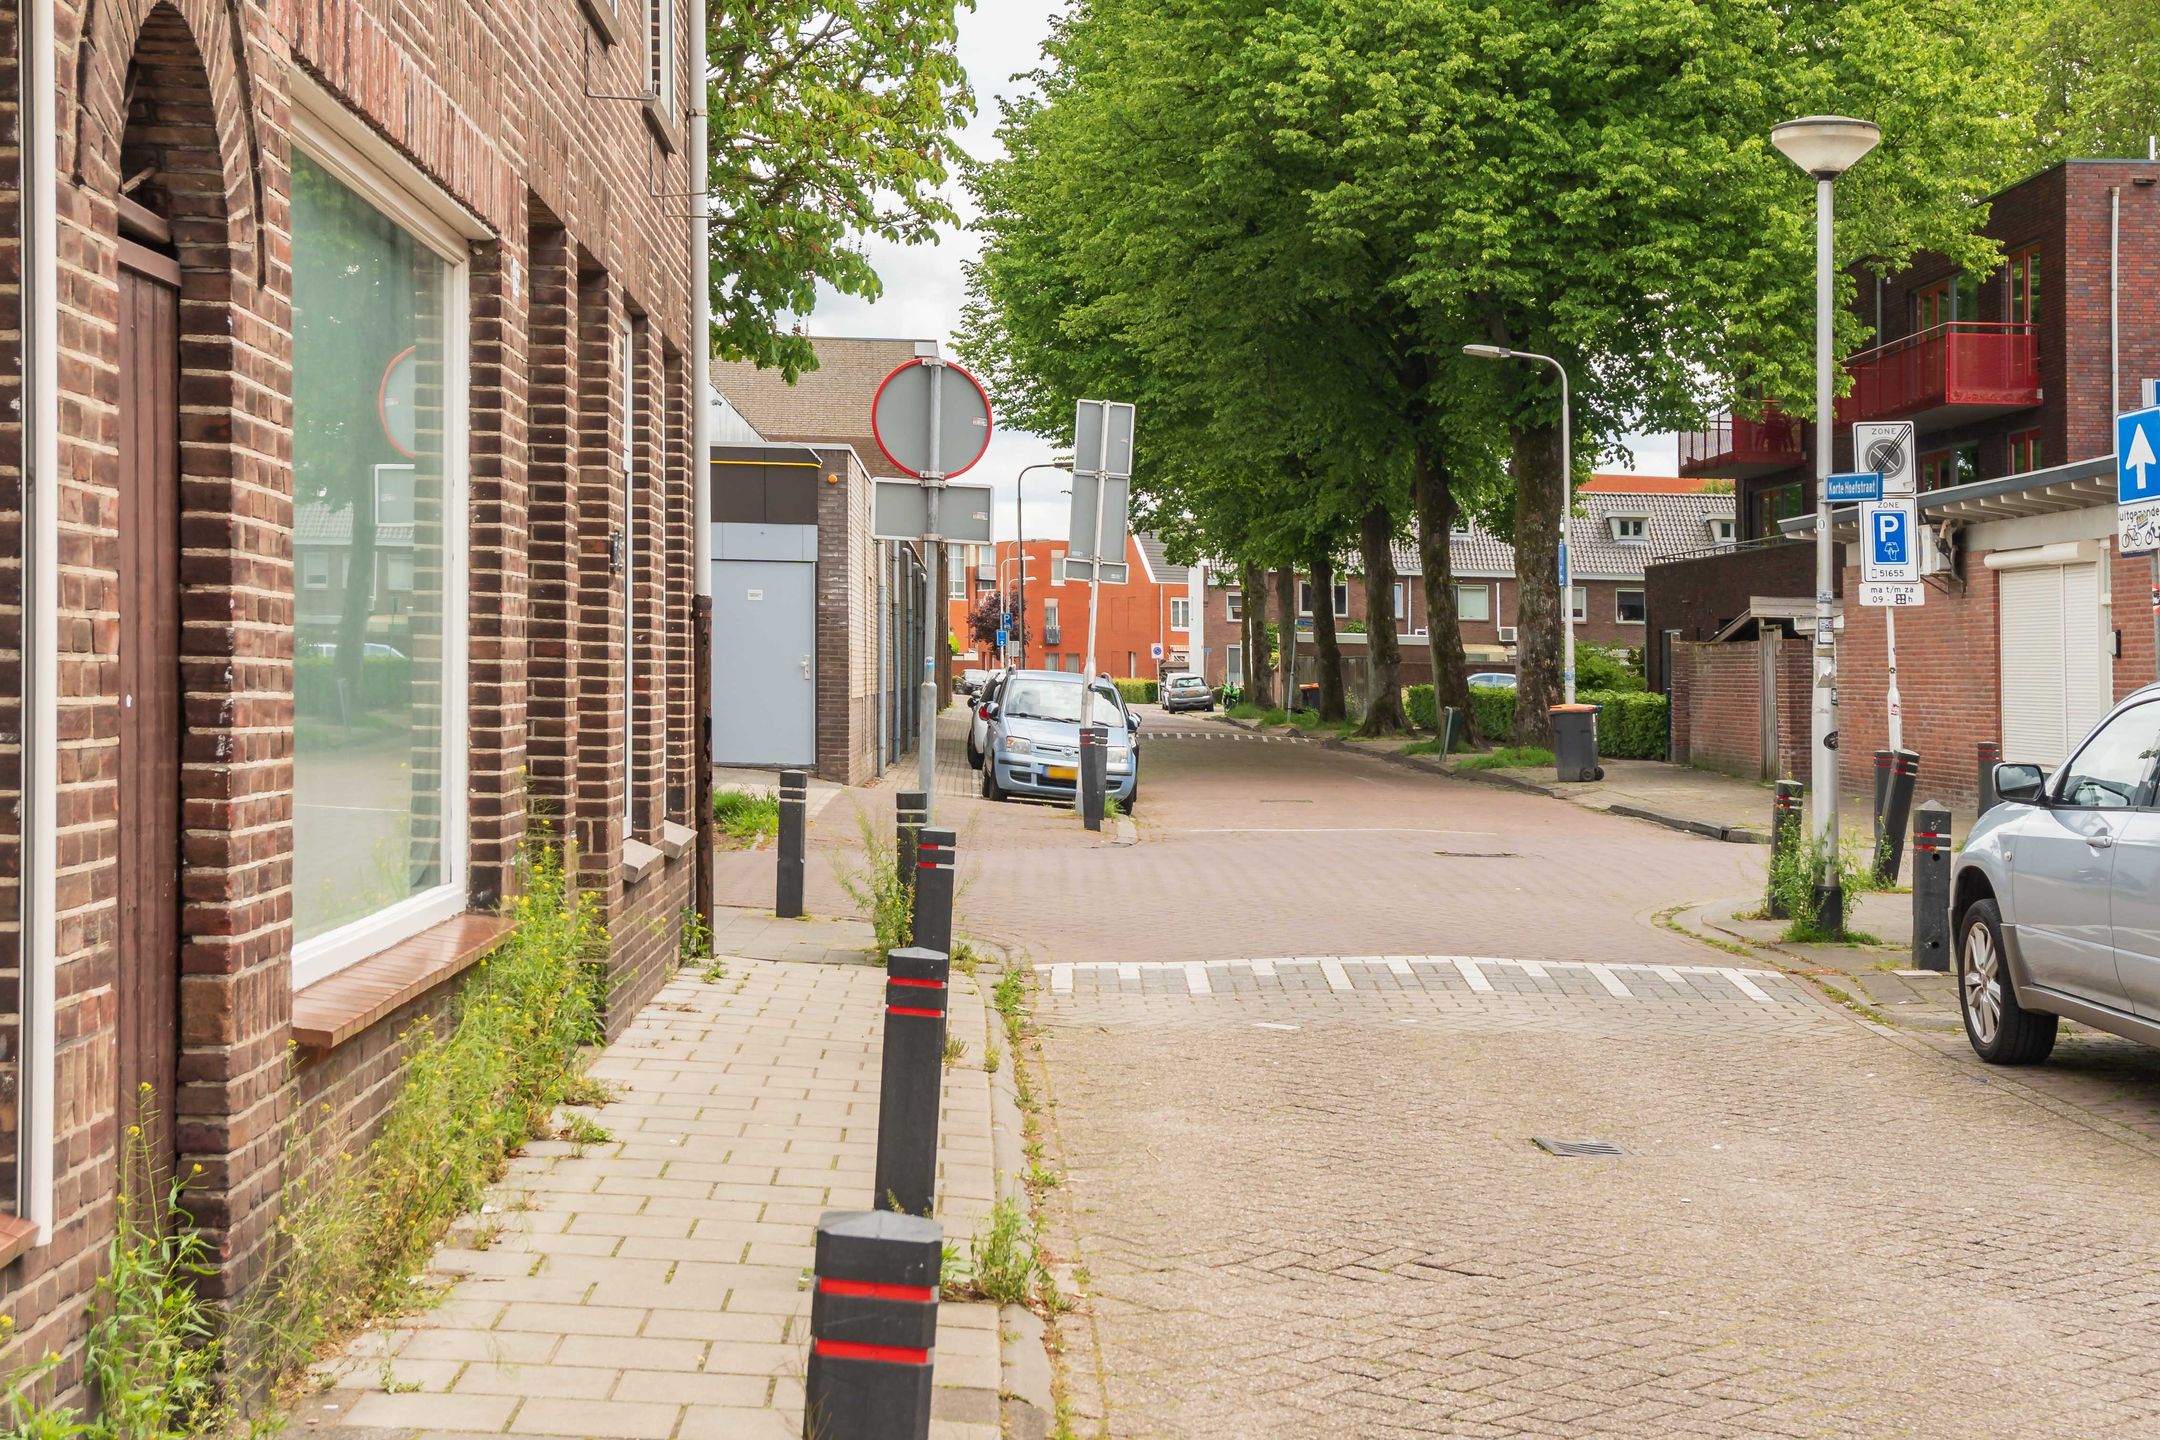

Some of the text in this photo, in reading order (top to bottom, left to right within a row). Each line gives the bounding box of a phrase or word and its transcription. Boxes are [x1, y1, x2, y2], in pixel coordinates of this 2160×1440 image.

[1829, 480, 1875, 495] Korte Hoefstraat
[1879, 515, 1899, 542] P
[1879, 569, 1905, 577] 51655
[1872, 595, 1884, 603] 09
